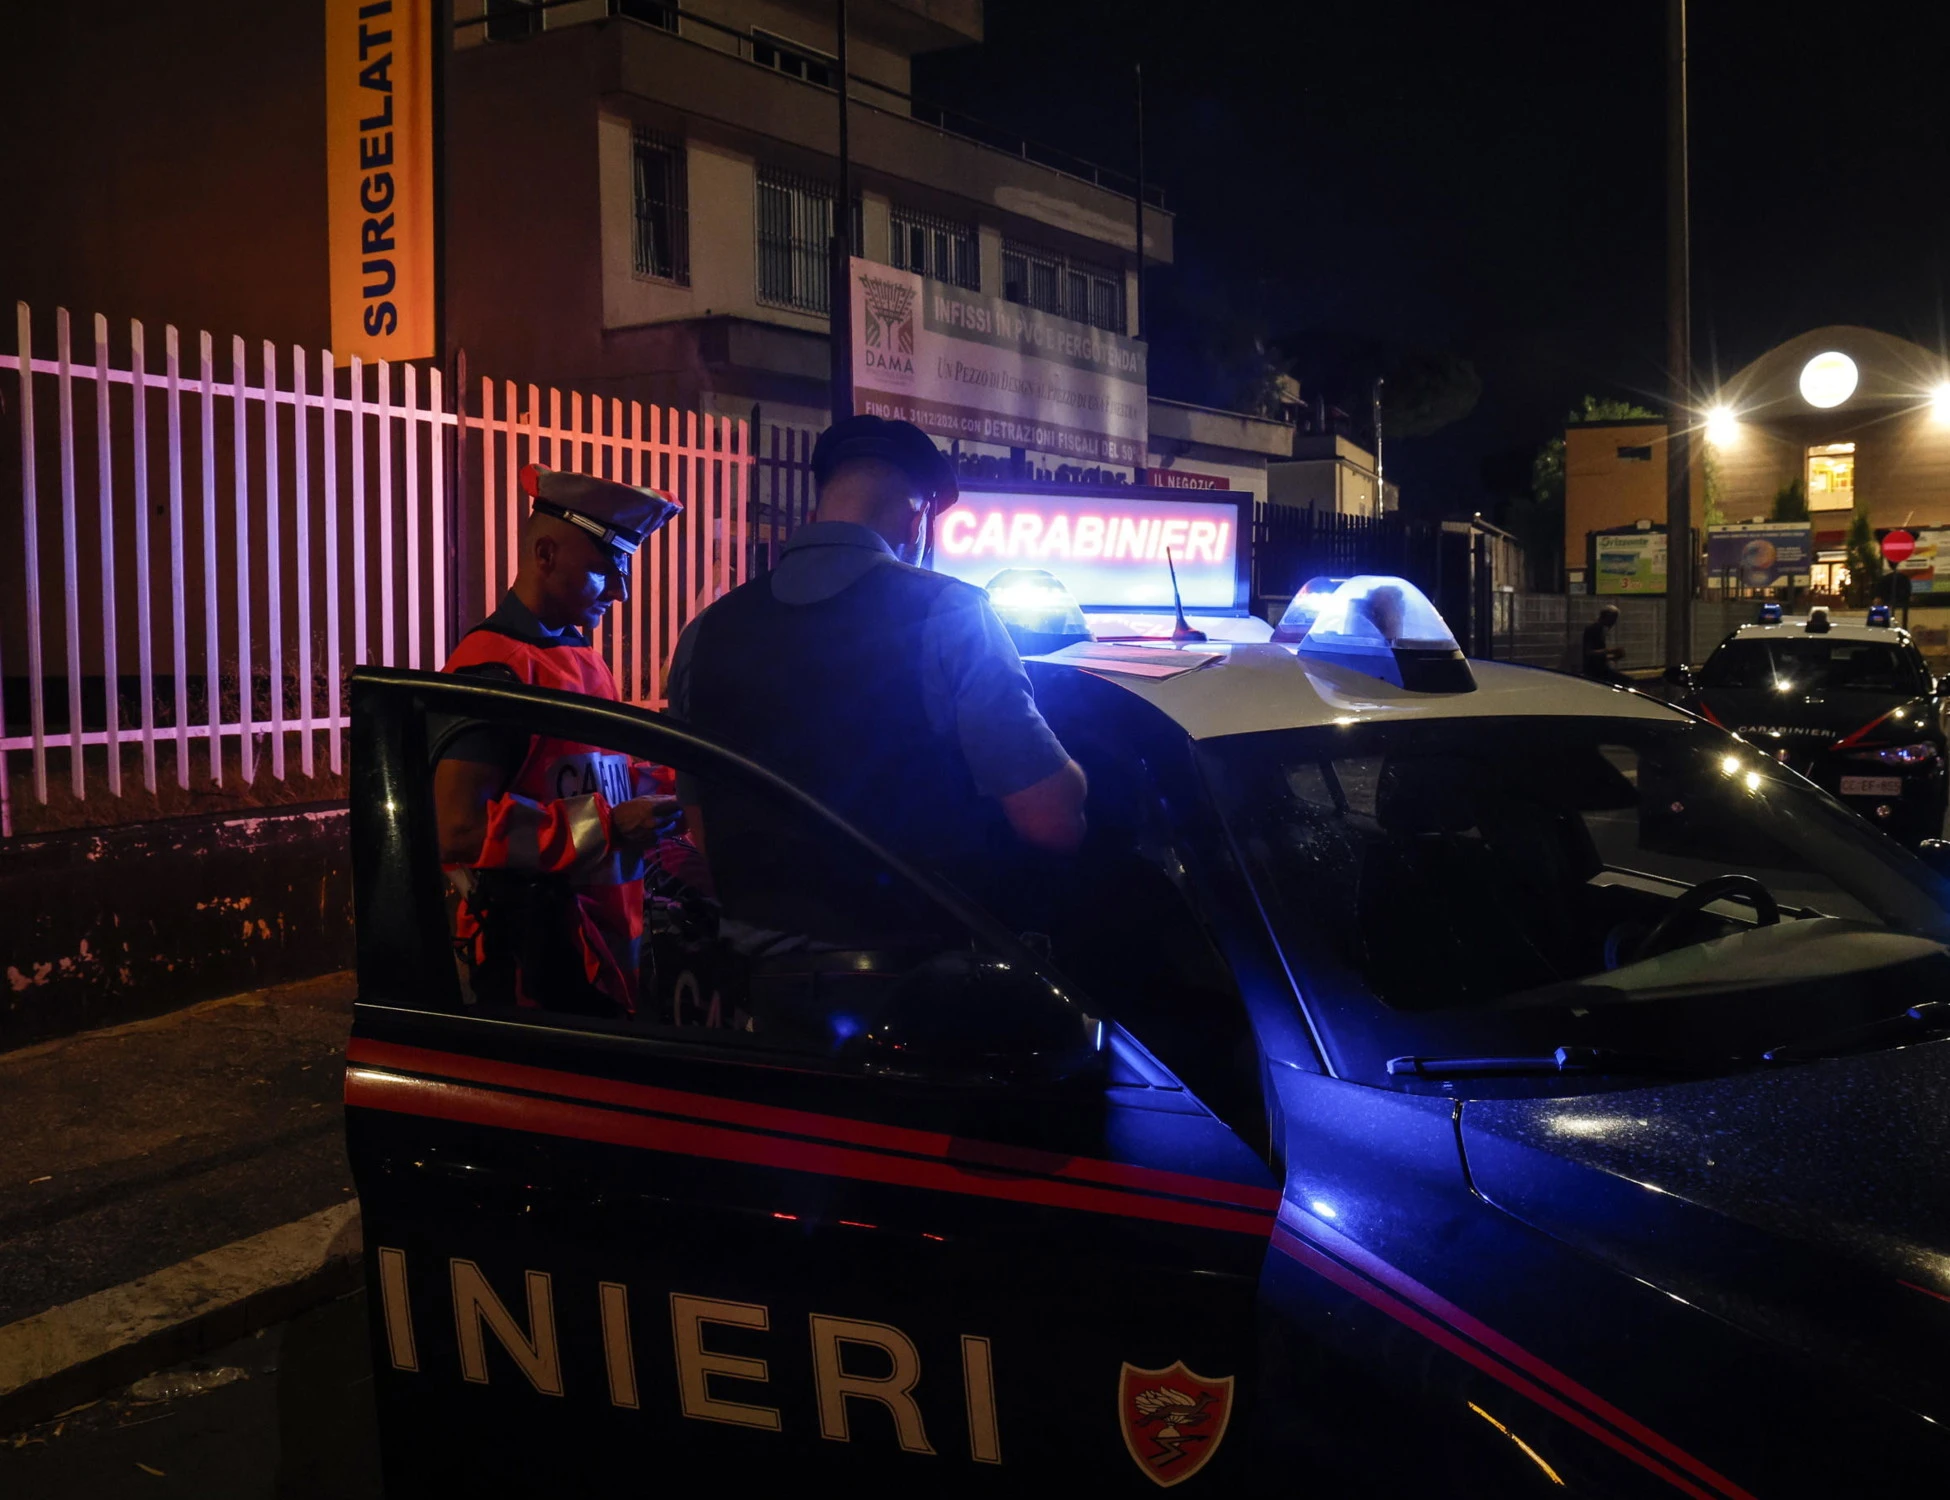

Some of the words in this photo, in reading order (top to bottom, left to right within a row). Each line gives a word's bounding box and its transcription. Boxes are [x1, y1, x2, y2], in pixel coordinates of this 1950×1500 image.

[358, 0, 398, 337] SURGELATI
[934, 295, 992, 334] INFISSI
[996, 310, 1012, 340] IN
[865, 349, 915, 375] DAMA
[954, 361, 989, 387] PEZZO
[865, 401, 891, 418] FINO
[893, 406, 907, 421] AL
[910, 408, 958, 429] 31/12/2024
[961, 418, 981, 433] CON
[984, 417, 1054, 446] DETRAZIONI
[1058, 432, 1098, 456] FISCALI
[1102, 440, 1119, 459] DEL
[1154, 473, 1164, 488] IL
[941, 510, 1229, 560] CARABINIERI
[1738, 725, 1837, 738] CARABINIERI
[378, 1246, 1002, 1465] INIERI
